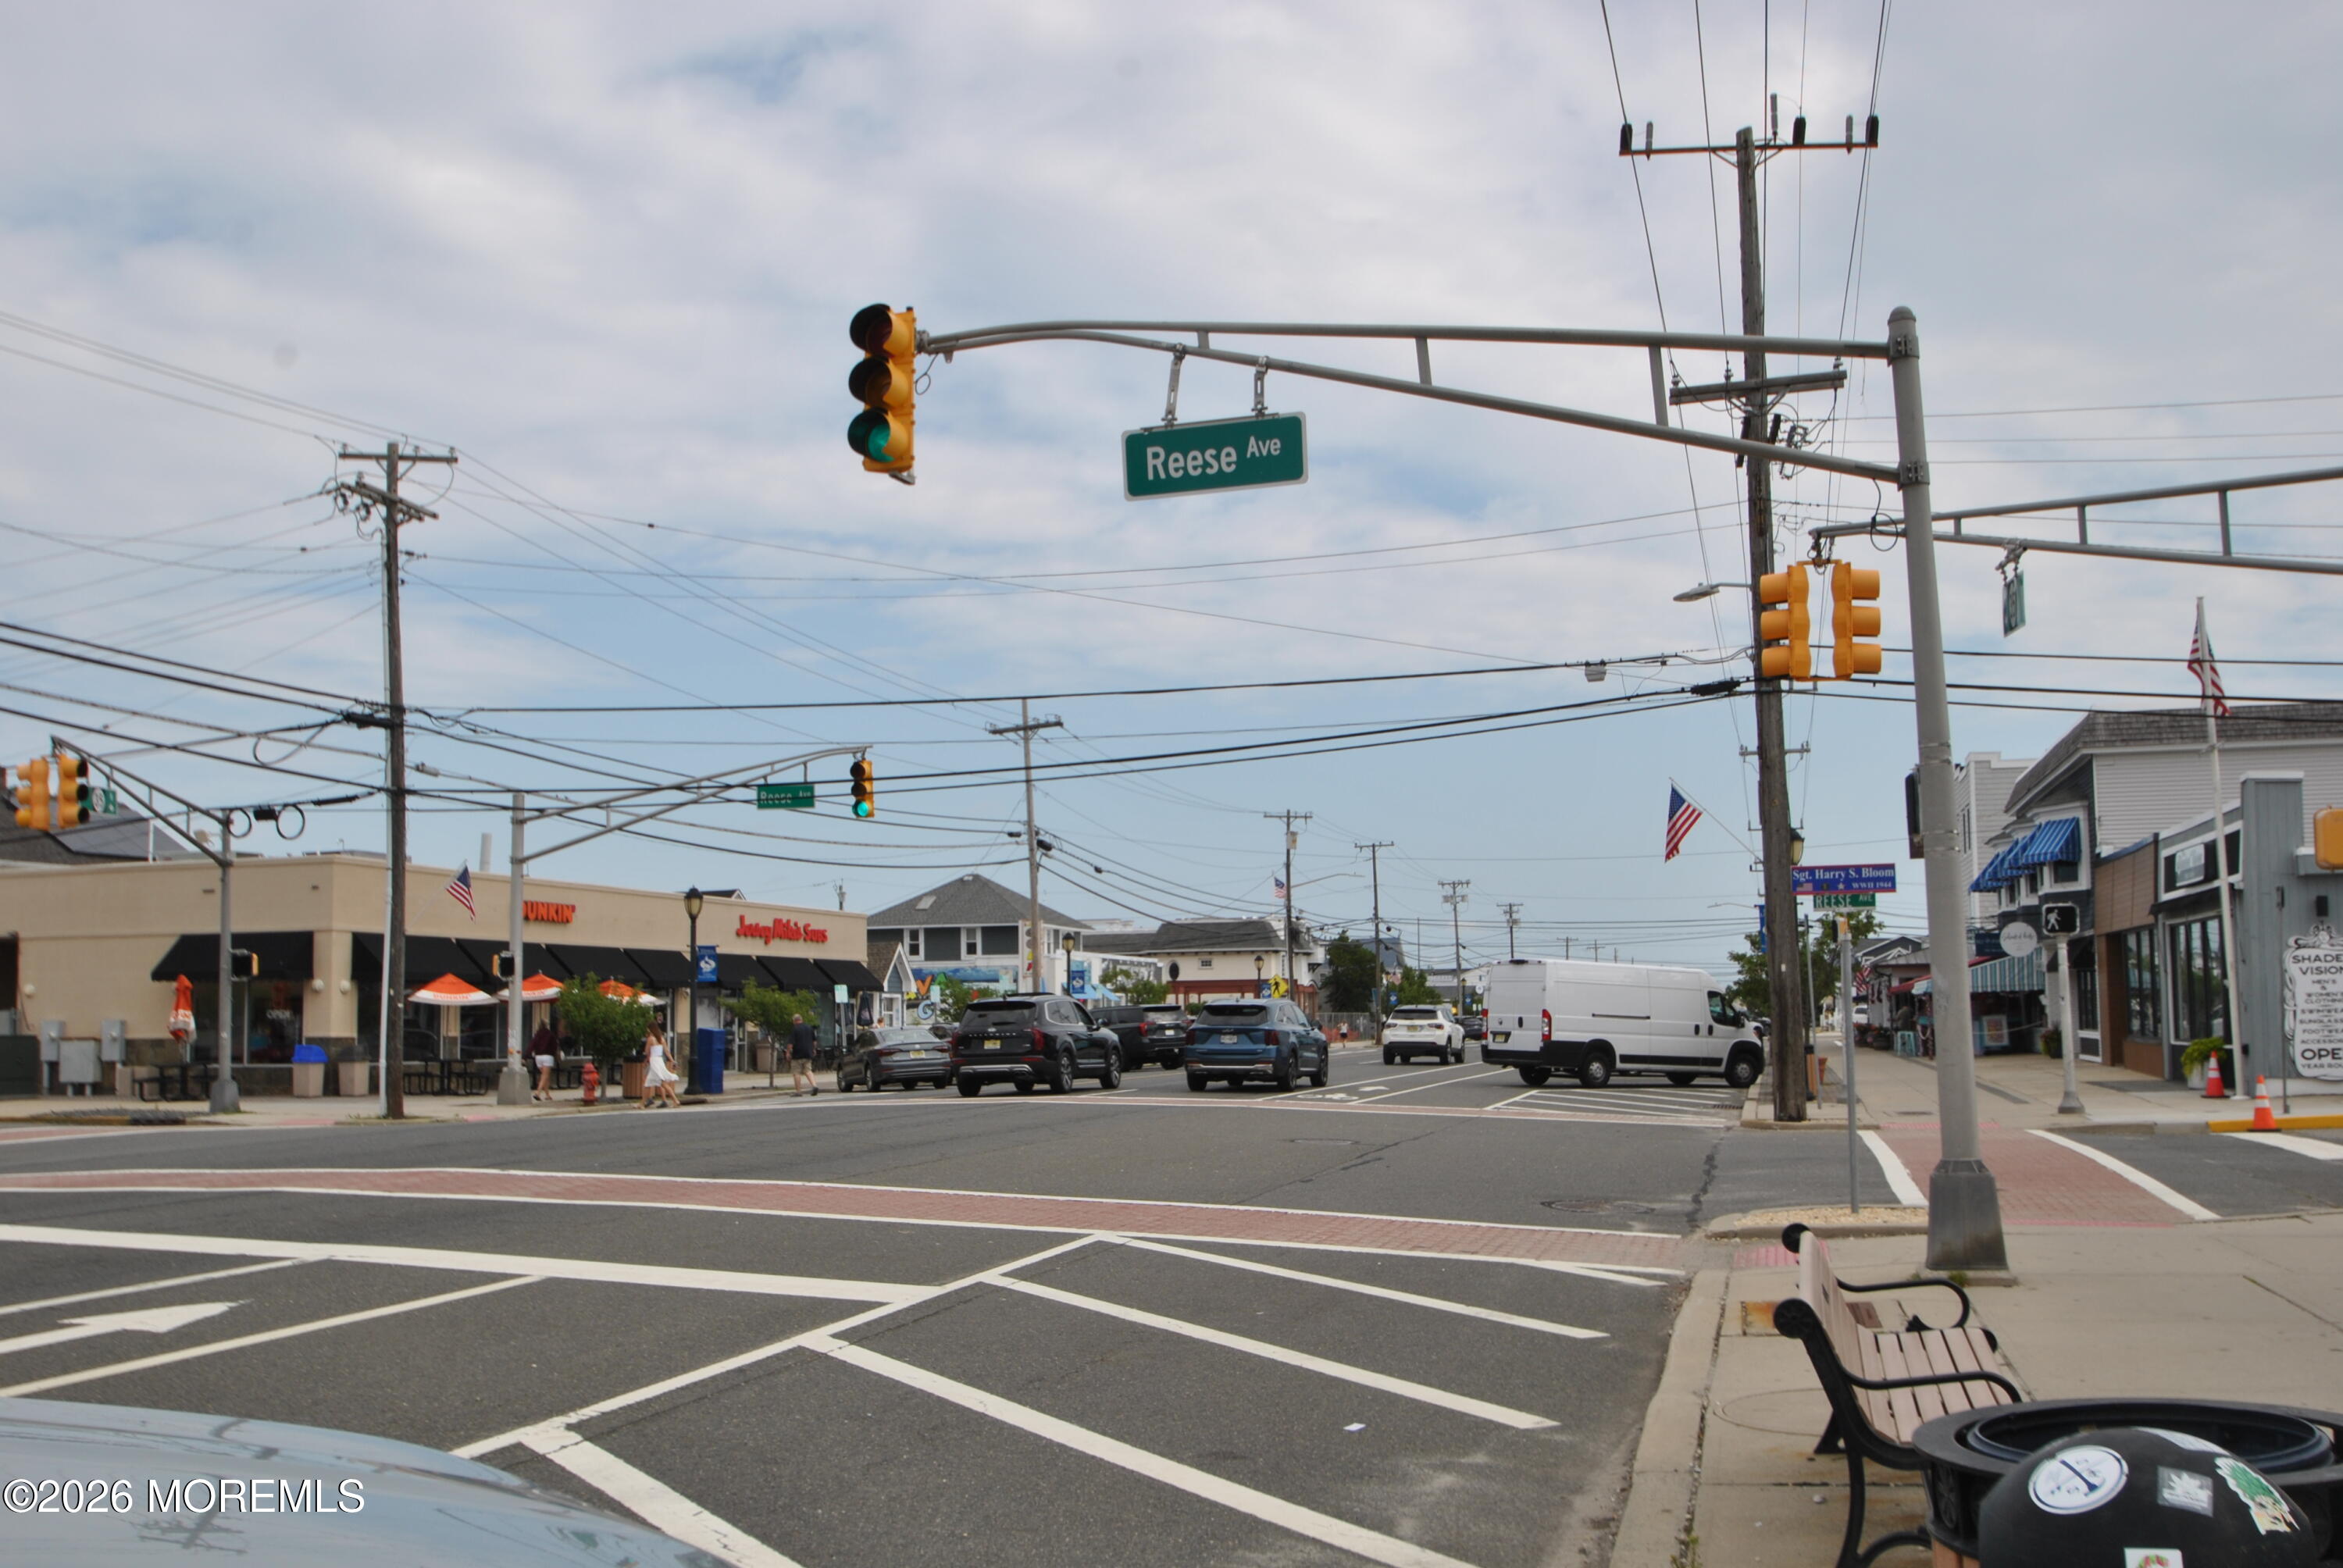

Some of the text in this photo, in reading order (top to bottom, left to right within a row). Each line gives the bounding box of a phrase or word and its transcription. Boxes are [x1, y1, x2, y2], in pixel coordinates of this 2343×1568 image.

[1147, 436, 1282, 481] Reese Ave
[1792, 867, 1894, 882] Sgt. Harry S. Bloom
[1815, 895, 1853, 908] REESE
